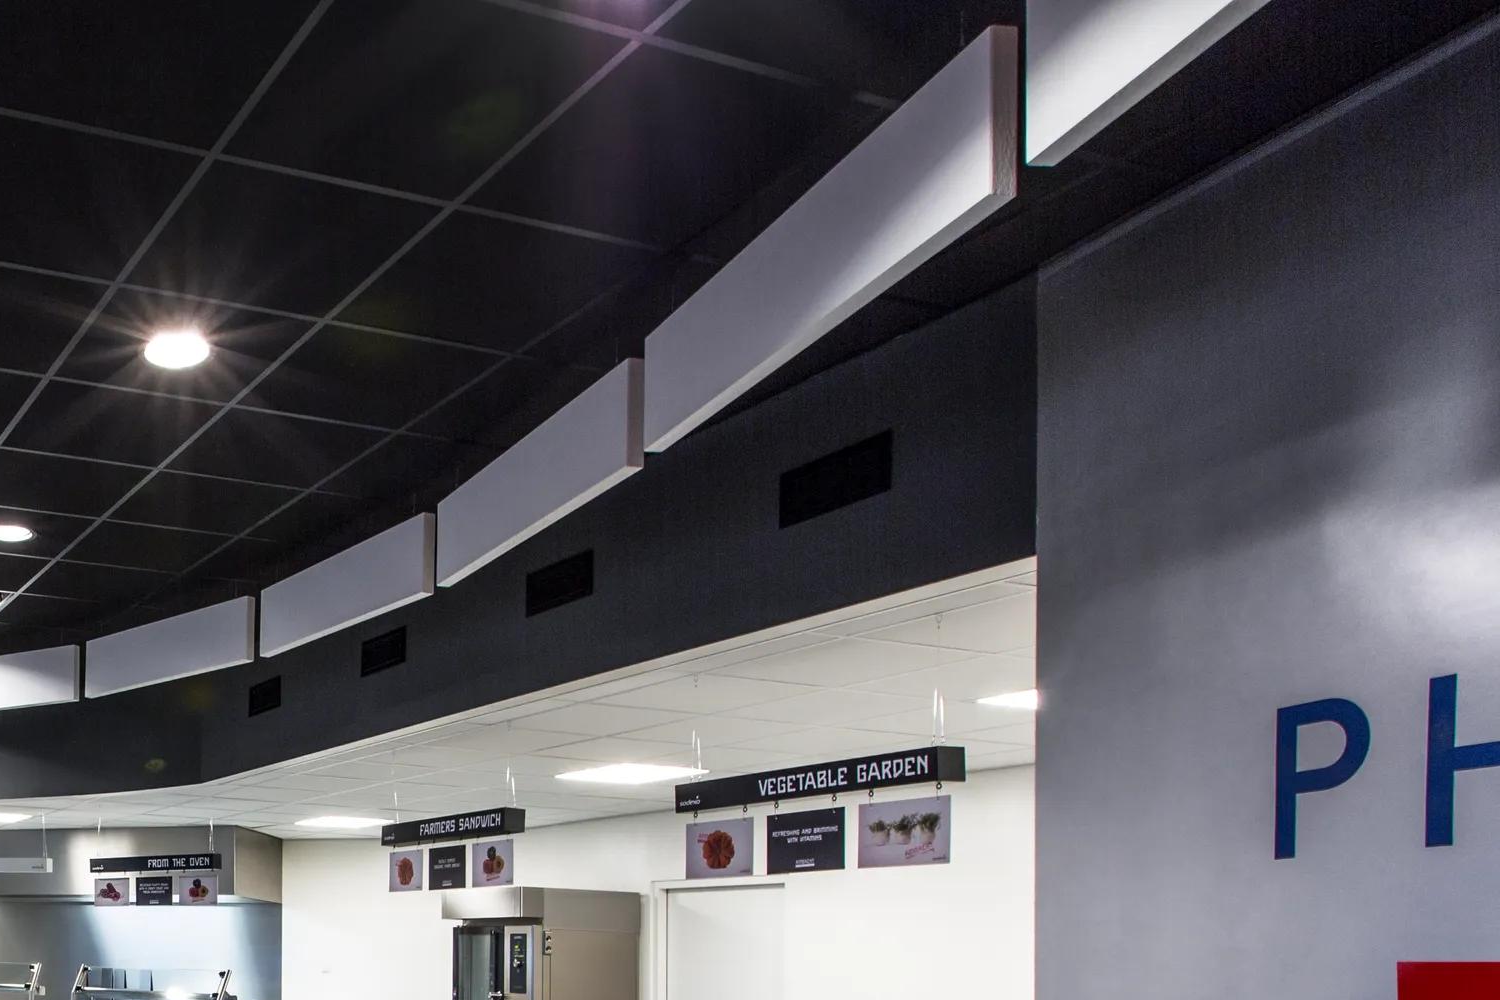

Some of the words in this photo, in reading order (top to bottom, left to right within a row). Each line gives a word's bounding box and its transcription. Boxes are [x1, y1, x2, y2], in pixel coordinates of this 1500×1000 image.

[758, 767, 848, 797] VEGETABLE
[857, 755, 929, 783] GARDEN
[419, 819, 456, 836] FARMERS
[458, 813, 501, 831] SANDWICH
[147, 858, 169, 868] FROM
[173, 858, 186, 867] THE
[189, 857, 210, 867] OVEN
